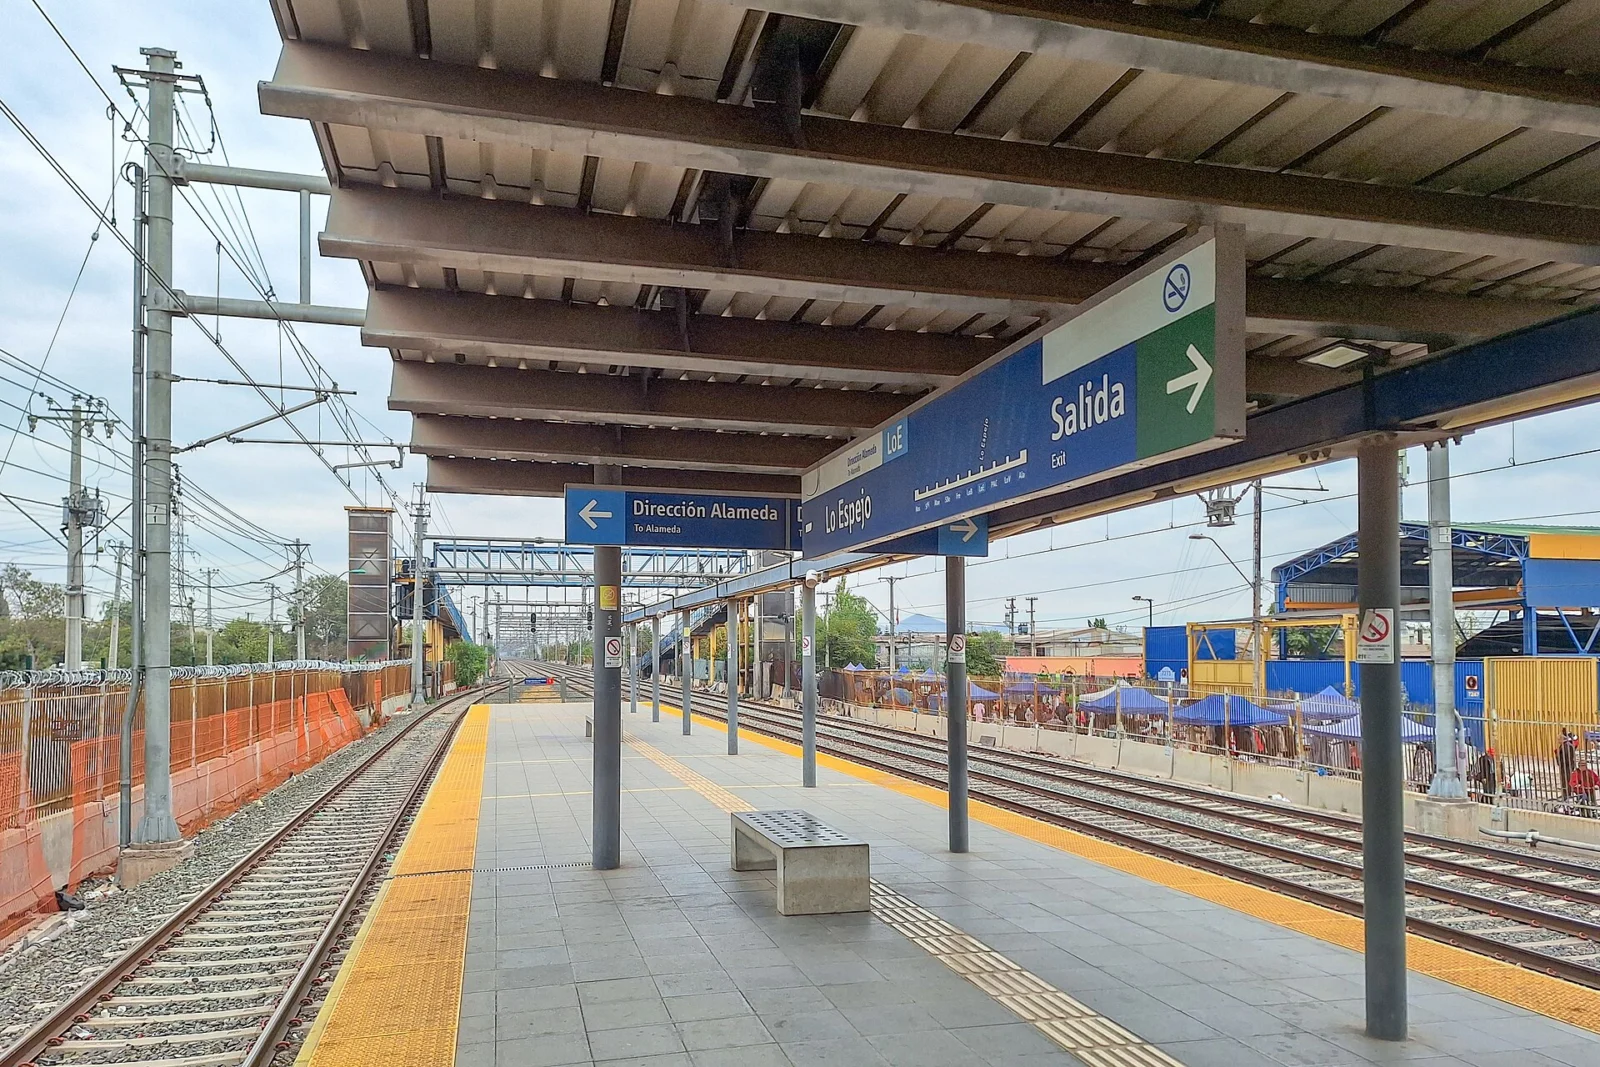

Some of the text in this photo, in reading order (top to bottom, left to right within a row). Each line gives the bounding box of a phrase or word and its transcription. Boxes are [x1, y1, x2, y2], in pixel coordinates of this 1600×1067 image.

[1051, 373, 1125, 441] Salida
[886, 424, 903, 456] LoE
[1051, 450, 1066, 468] Exit
[153, 505, 158, 513] 7
[633, 499, 706, 518] Dirección
[710, 503, 778, 521] Alameda
[825, 505, 836, 534] Lo
[838, 487, 872, 535] Espejo
[634, 524, 681, 534] To Alameda
